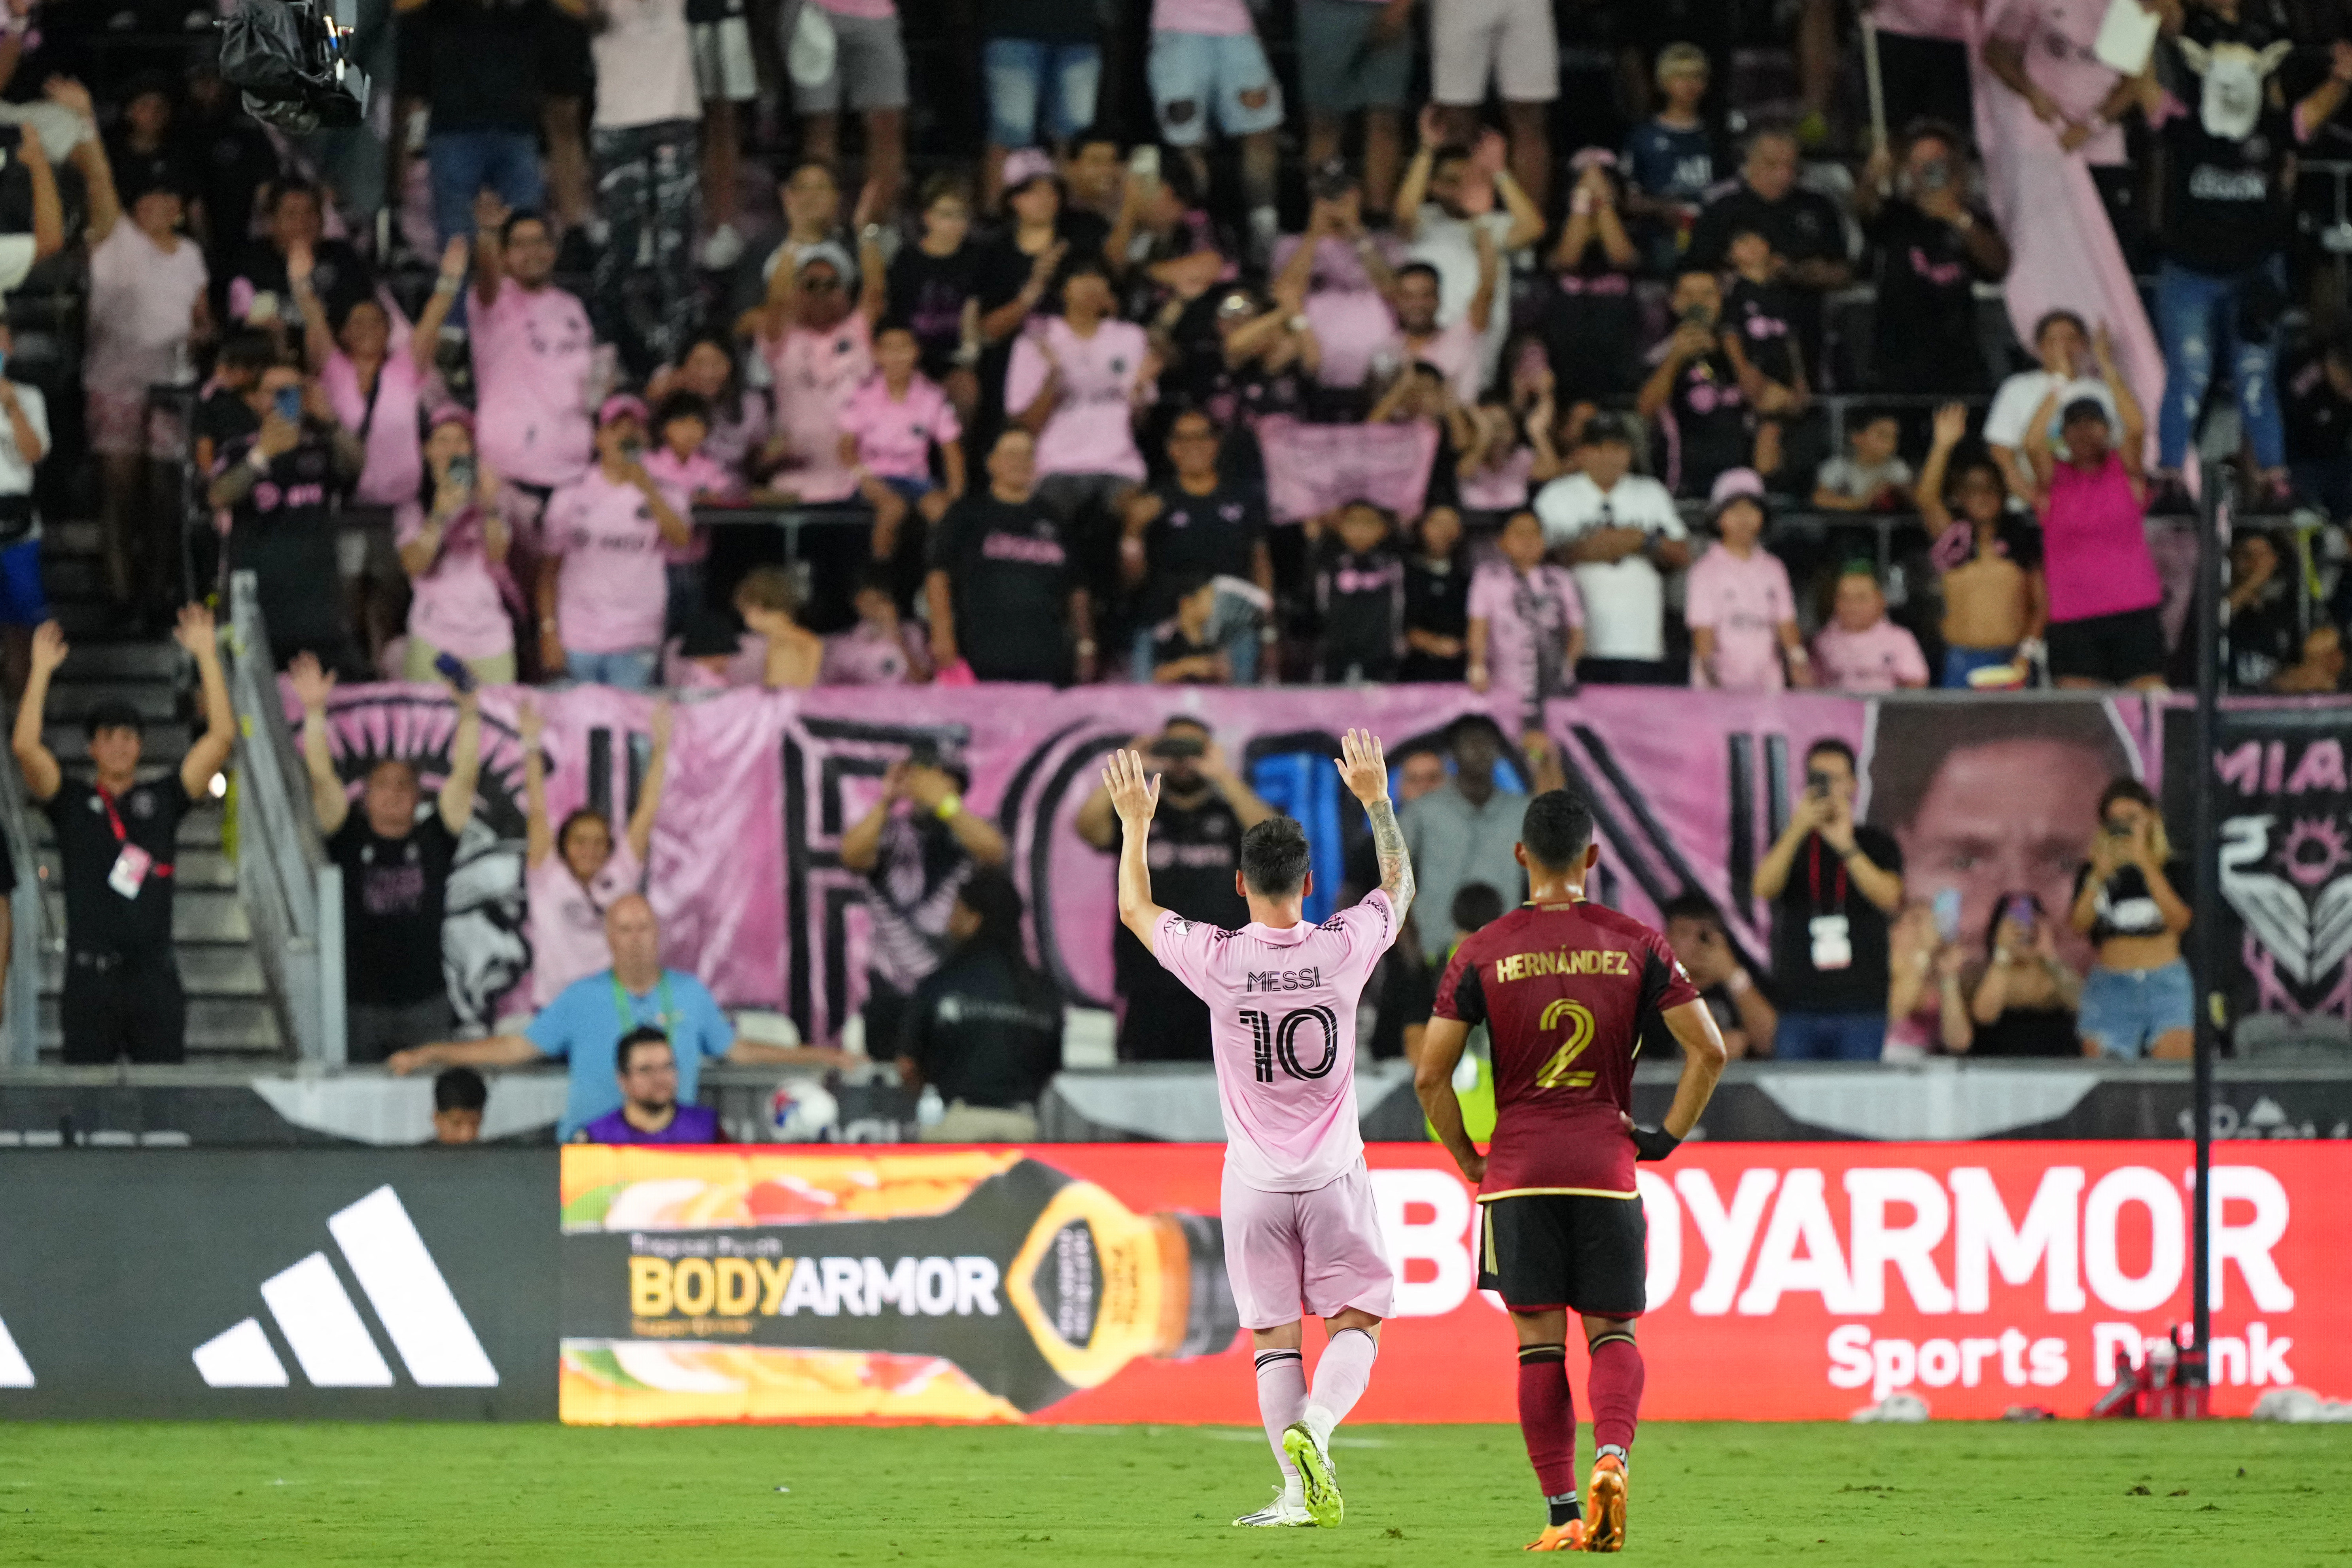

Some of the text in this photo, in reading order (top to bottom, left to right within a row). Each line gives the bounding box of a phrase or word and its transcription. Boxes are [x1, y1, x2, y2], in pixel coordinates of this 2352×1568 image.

[2213, 737, 2352, 796] MIA
[1247, 966, 1321, 993] MESSI
[1496, 944, 1630, 984] HERNÁNDEZ
[1239, 1005, 1338, 1083] 10
[1536, 998, 1596, 1088] 2
[1369, 1165, 2296, 1317] BYARMOR
[628, 1256, 1002, 1318] BODYARMOR
[1827, 1320, 2294, 1401] Sports Dnk
